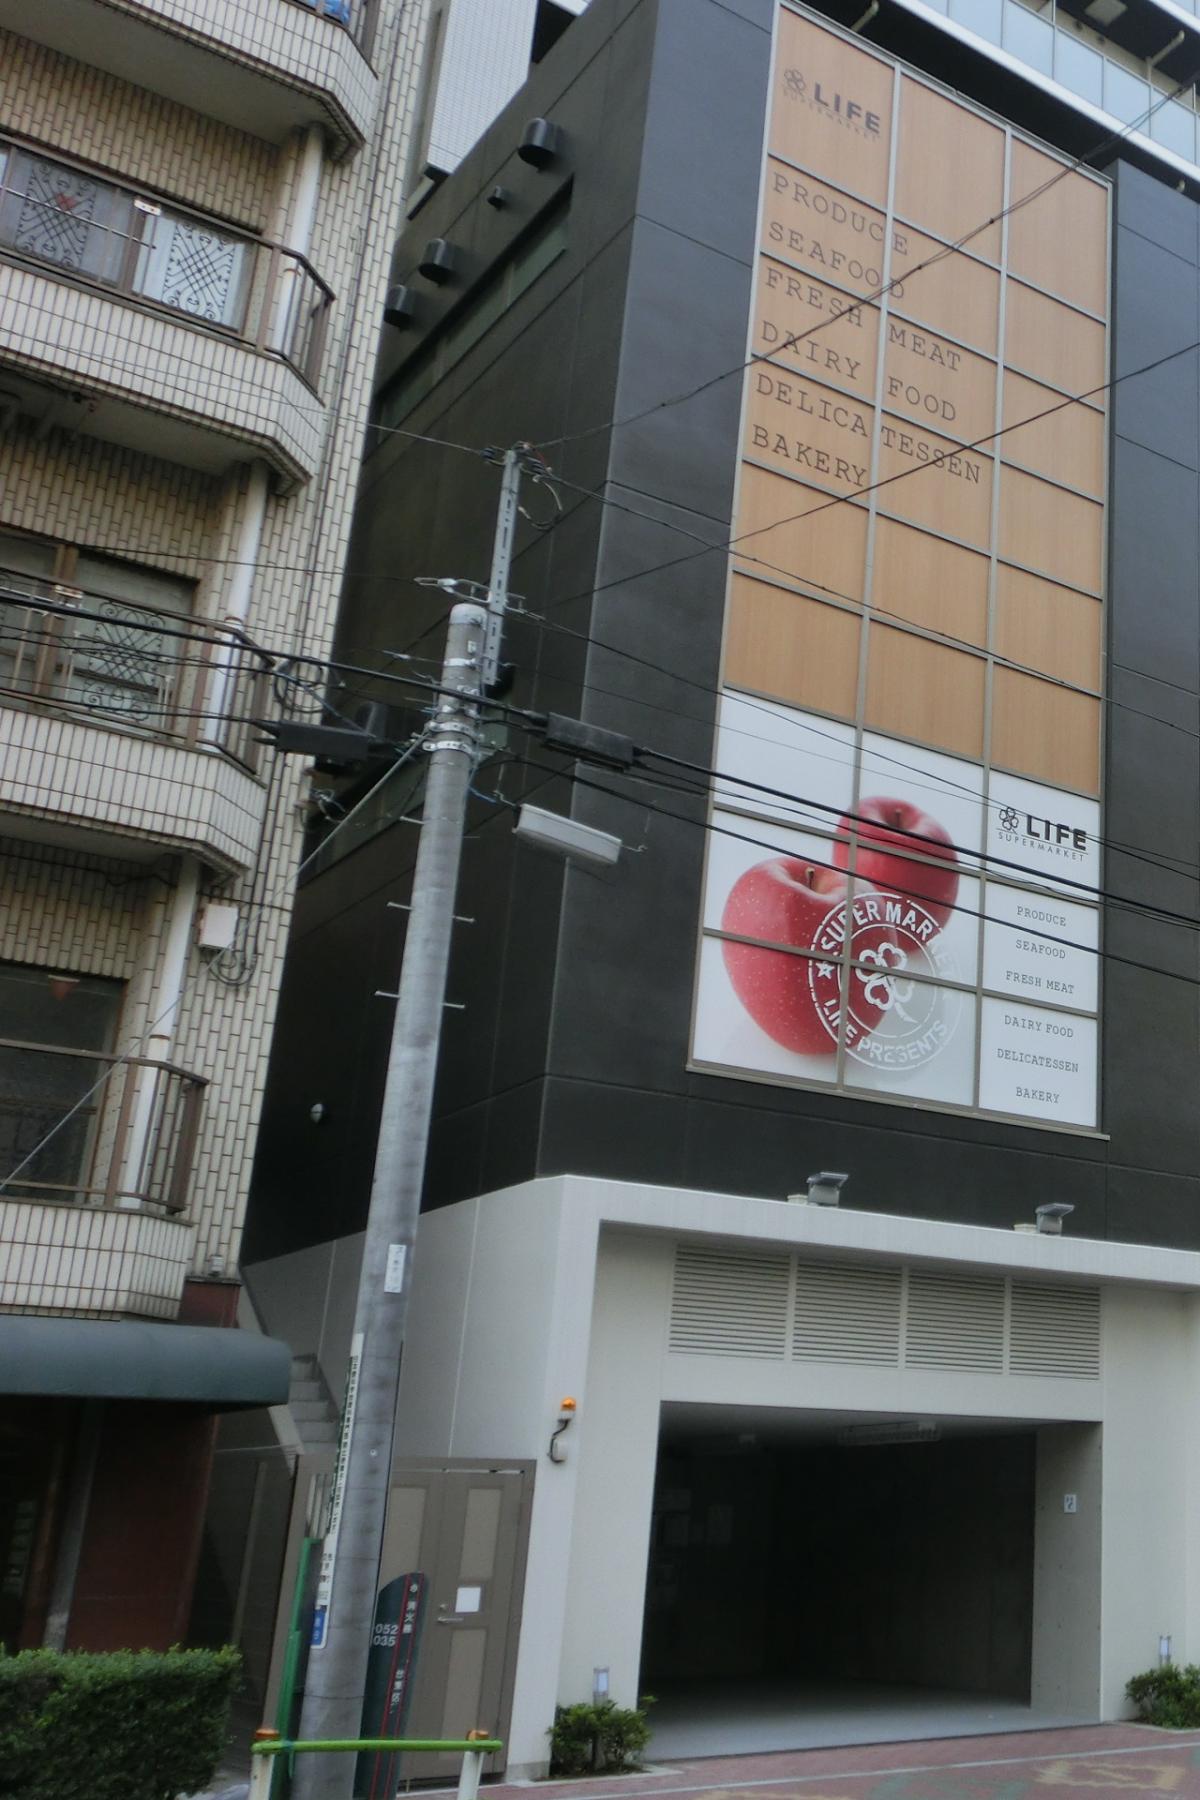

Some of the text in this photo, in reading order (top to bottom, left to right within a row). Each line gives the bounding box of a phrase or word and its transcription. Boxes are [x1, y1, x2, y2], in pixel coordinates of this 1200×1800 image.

[814, 82, 880, 134] LIFE
[773, 172, 908, 256] PRODUCE
[769, 221, 905, 299] SEAFOOD
[765, 267, 961, 371] FRESH MEAT
[761, 320, 956, 422] DAIRY FOOD
[755, 373, 981, 484] DELICATESSEN
[752, 424, 868, 487] BAKERY
[998, 832, 1085, 862] SUPERMARKET
[1026, 815, 1087, 851] LIFE
[1016, 905, 1067, 927] PRODUCE
[1015, 939, 1066, 959] SEAFOOD
[1005, 970, 1074, 994] FRESH MEAT
[857, 1020, 948, 1063] PRESENTS
[1004, 1015, 1074, 1038] DAIRY FOOD
[997, 1048, 1079, 1073] DELICATESSEN
[1016, 1086, 1060, 1104] BAKERY
[373, 1635, 396, 1647] 035
[375, 1623, 399, 1635] 052
